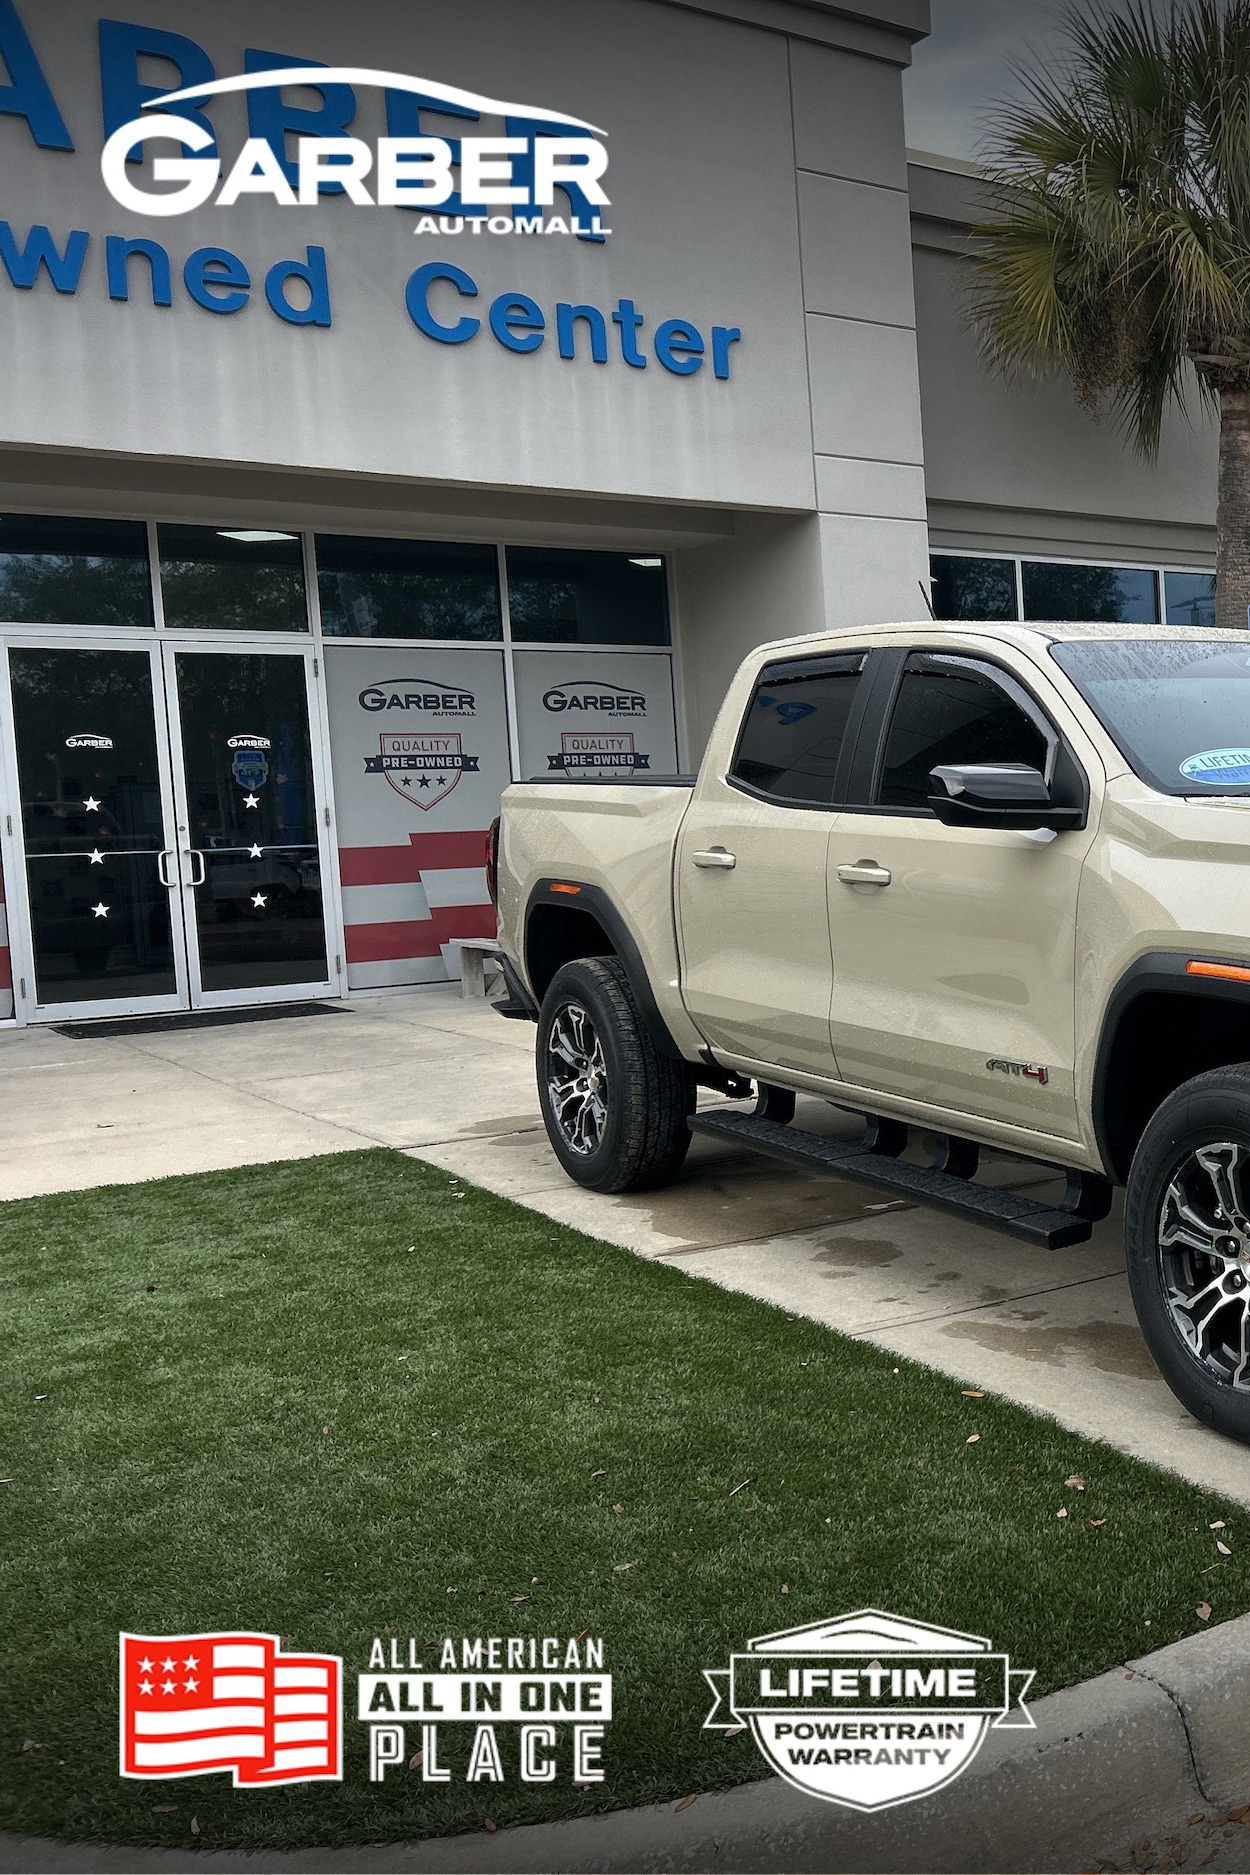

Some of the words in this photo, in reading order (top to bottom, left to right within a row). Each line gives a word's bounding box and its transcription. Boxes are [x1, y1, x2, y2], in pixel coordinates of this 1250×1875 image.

[0, 220, 332, 327] wned
[405, 262, 741, 380] Center
[358, 688, 476, 712] GARBER
[542, 690, 647, 712] GARBER
[65, 738, 113, 748] GARBER
[227, 738, 271, 748] GARBER
[392, 740, 450, 752] QUALITY
[572, 739, 624, 750] QUALITY
[382, 756, 462, 768] PRE-OWNED
[563, 754, 635, 766] PRE-OWNED
[985, 1057, 1049, 1086] AT4
